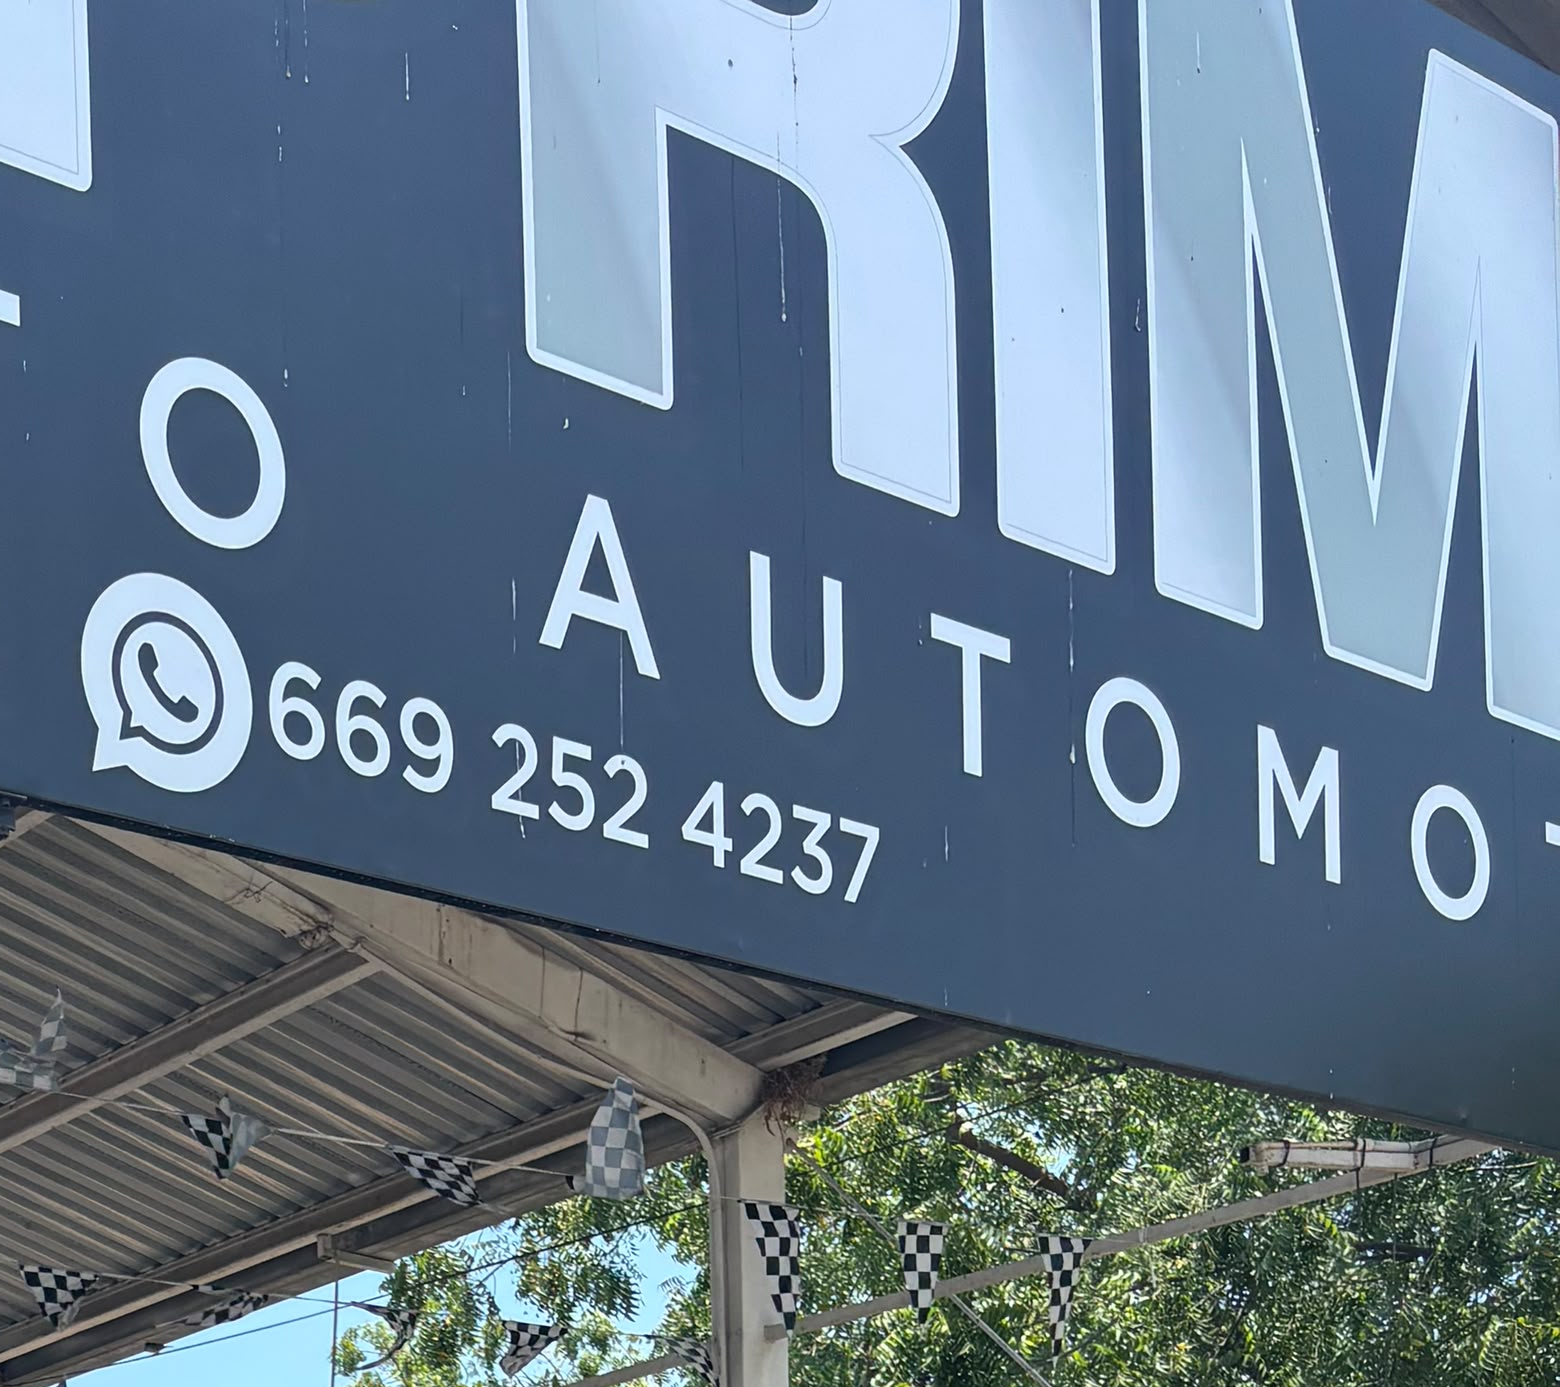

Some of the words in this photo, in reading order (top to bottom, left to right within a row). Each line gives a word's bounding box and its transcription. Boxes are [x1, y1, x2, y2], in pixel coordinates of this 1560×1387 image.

[269, 662, 453, 792] 669
[492, 724, 648, 848] 252
[682, 781, 879, 902] 4237
[539, 494, 1560, 920] AUTOMO
